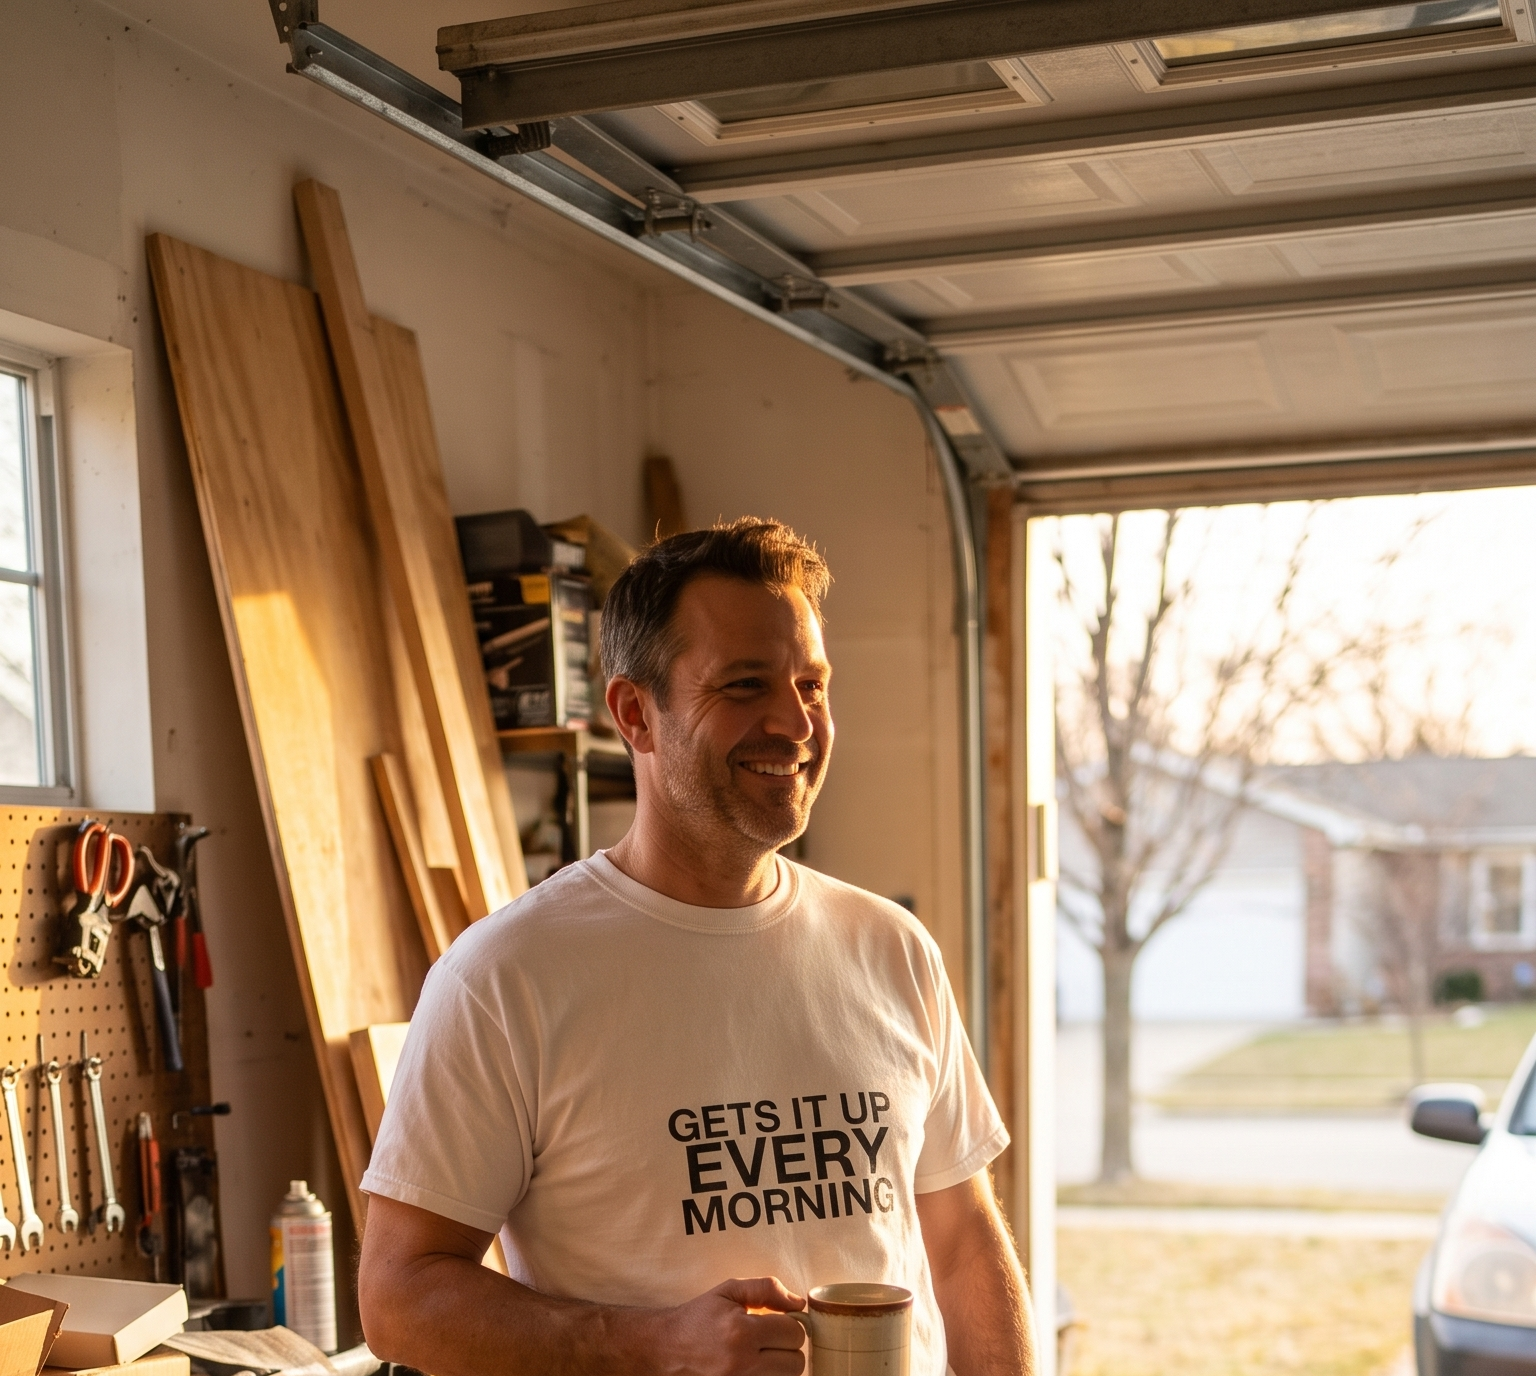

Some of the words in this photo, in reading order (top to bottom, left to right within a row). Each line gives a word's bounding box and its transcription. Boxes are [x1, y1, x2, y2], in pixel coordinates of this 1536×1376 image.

[667, 1099, 781, 1143] GETS
[791, 1094, 828, 1130] IT
[839, 1090, 891, 1125] UP
[685, 1126, 889, 1195] EVERY
[681, 1177, 894, 1236] MORNING
